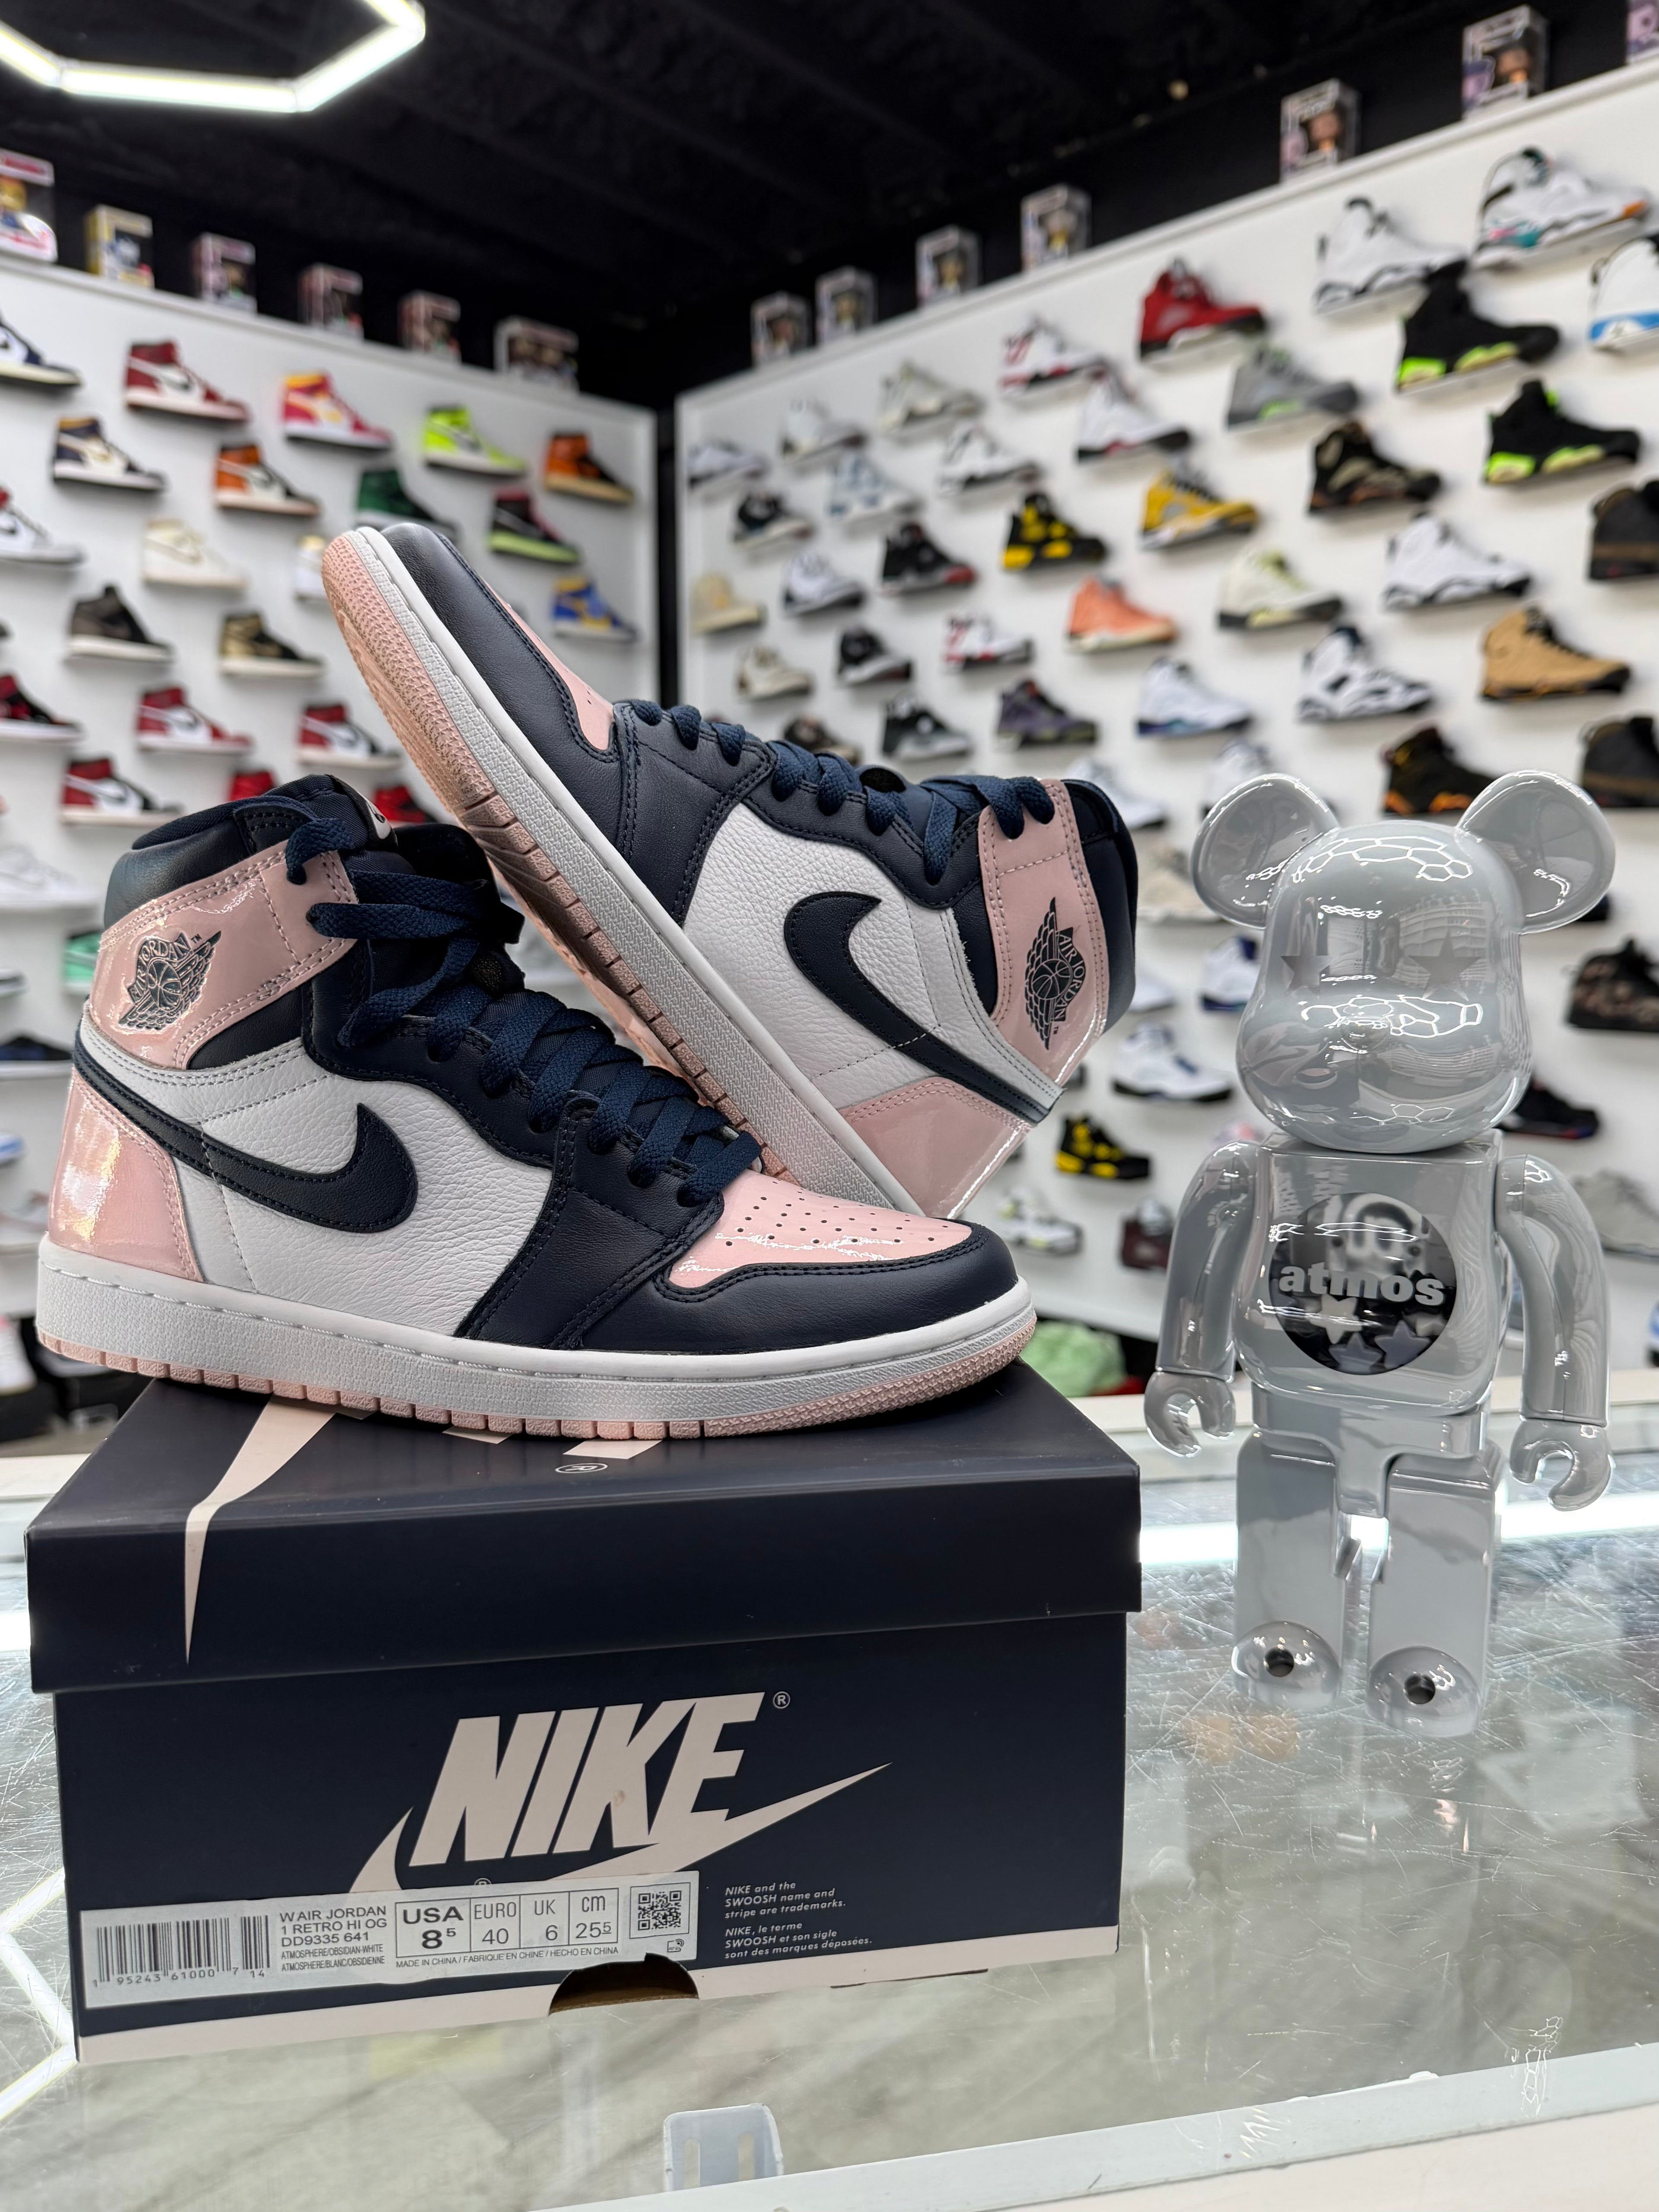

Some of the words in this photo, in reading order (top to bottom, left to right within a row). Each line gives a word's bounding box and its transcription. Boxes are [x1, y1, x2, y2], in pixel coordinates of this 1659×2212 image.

[139, 936, 190, 968] JORDAN
[1059, 934, 1077, 963] AIR
[1054, 960, 1085, 1020] JORDAN
[1278, 1262, 1446, 1306] atmos
[409, 1691, 765, 1867] NIKE
[725, 1885, 751, 1896] NIKE
[754, 1882, 776, 1893] and
[779, 1881, 796, 1890] the
[725, 1894, 777, 1907] SWOOSH
[780, 1892, 810, 1901] name
[814, 1888, 835, 1898] and
[297, 1910, 322, 1921] AIR
[326, 1905, 386, 1919] JORDAN
[403, 1906, 464, 1924] USA
[474, 1902, 517, 1920] EURO
[534, 1899, 556, 1915] UK
[725, 1909, 756, 1919] stripe
[781, 1899, 846, 1913] trademarks.
[281, 1925, 286, 1935] 1
[293, 1921, 343, 1934] RETRO
[347, 1920, 361, 1930] HI
[365, 1918, 387, 1928] OG
[545, 1925, 558, 1941] 6
[725, 1926, 755, 1937] NIKE,
[771, 1923, 803, 1932] terme
[282, 1933, 340, 1947] DD9335
[344, 1932, 369, 1942] 641
[482, 1928, 509, 1945] 40
[725, 1935, 776, 1948] SWOOSH
[779, 1934, 789, 1942] et
[813, 1929, 837, 1940] sigle
[281, 1944, 384, 1960] ATMOSPHERE/OBSIDIAN-WHITE
[725, 1950, 748, 1959] sont
[751, 1948, 769, 1956] des
[772, 1943, 818, 1954] marques
[821, 1936, 873, 1949] déposées.
[281, 1956, 385, 1971] ATMOSPHERE/BLANC/OBSIDIENNE
[396, 1959, 420, 1967] MADE
[432, 1957, 458, 1965] CHINA
[463, 1953, 504, 1963] FABRIQUE
[519, 1951, 544, 1959] CHINE
[550, 1948, 579, 1957] HECHO
[594, 1947, 619, 1955] CHINA
[92, 1979, 98, 1987] 1
[117, 1974, 161, 1985] 95243
[172, 1969, 215, 1980] 61000
[232, 1967, 239, 1975] 7
[250, 1969, 265, 1978] 14
